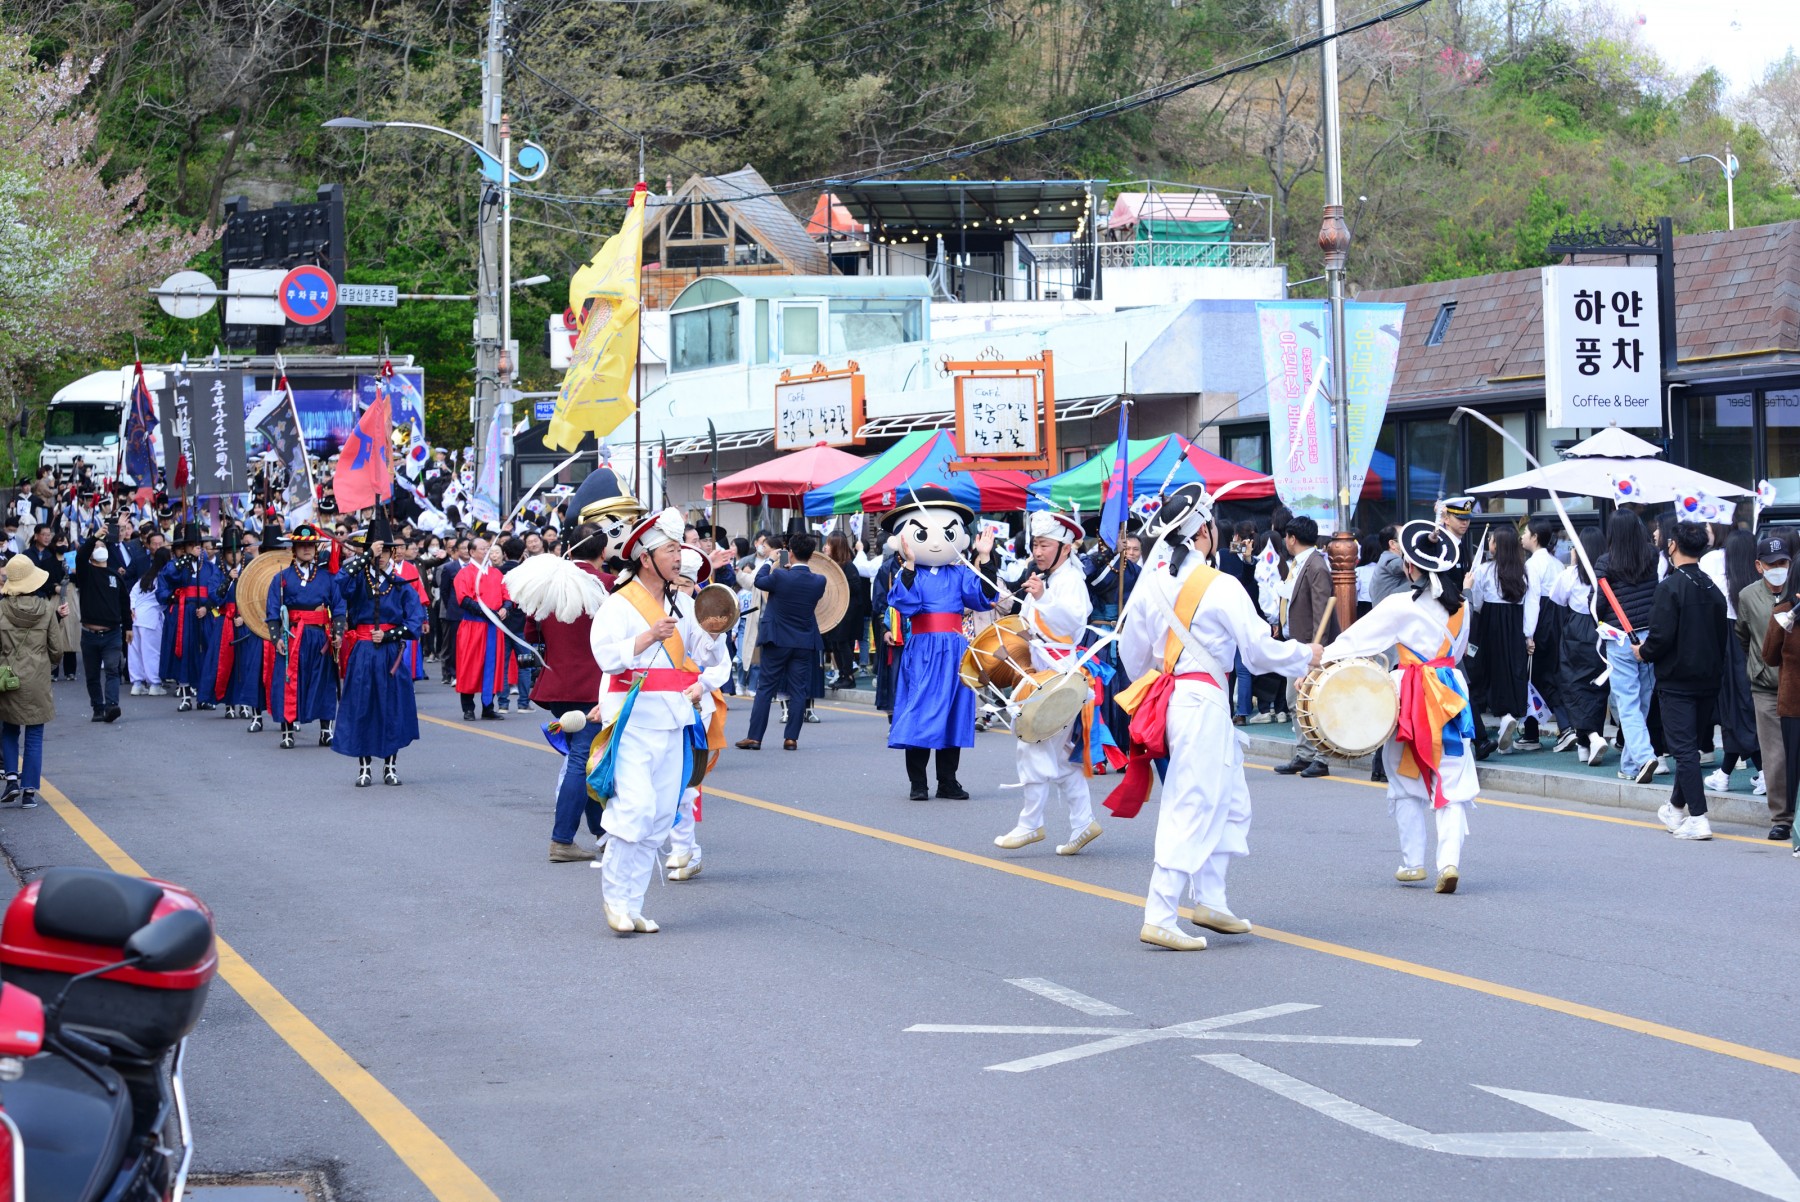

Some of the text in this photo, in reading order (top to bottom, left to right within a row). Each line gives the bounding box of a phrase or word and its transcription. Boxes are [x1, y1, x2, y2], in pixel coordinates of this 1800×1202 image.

[287, 290, 328, 301] 주차금지
[341, 288, 394, 302] 유달산일주도로
[1573, 289, 1643, 327] 하얀
[1575, 338, 1644, 376] 풍차
[1573, 395, 1650, 407] Coffee & Beer
[973, 403, 1028, 423] 복숭아꽃
[783, 405, 848, 442] 복숭아꽃 살구꽃
[974, 429, 1025, 448] 살구꽃
